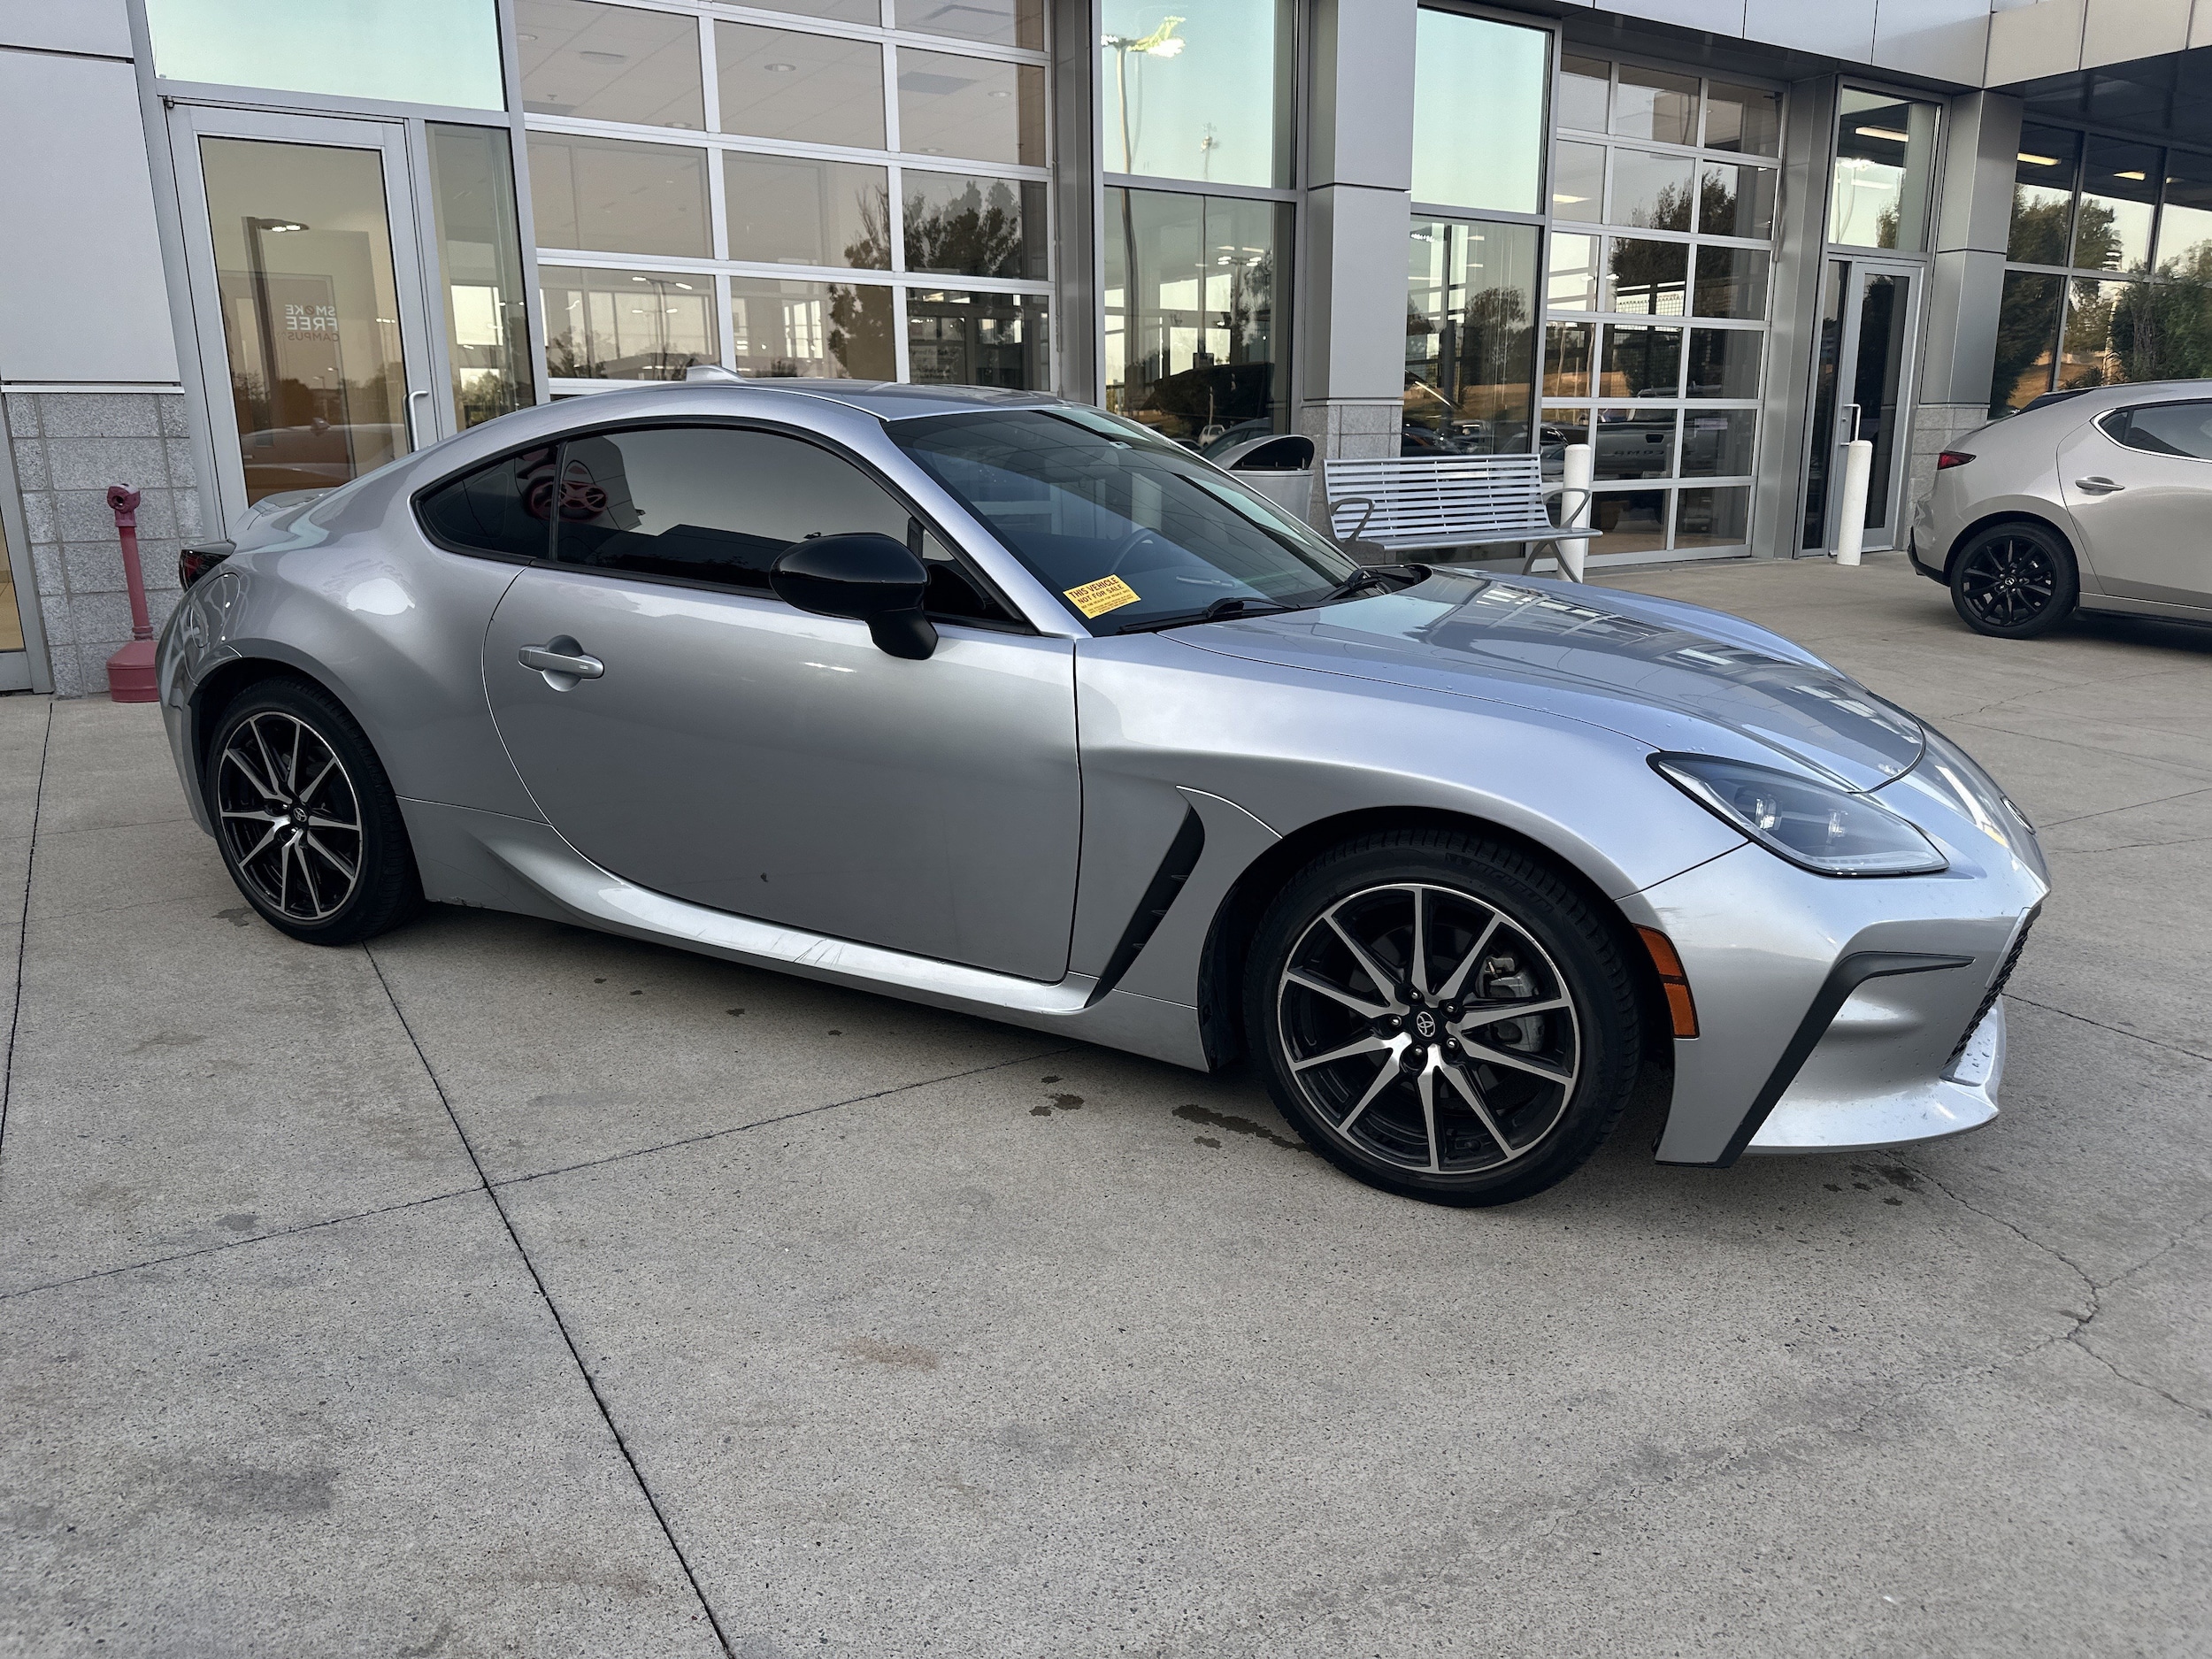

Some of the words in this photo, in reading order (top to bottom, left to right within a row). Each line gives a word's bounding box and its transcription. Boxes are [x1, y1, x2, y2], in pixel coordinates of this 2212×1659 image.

[1069, 588, 1088, 598] THIS
[1087, 577, 1119, 591] VEHICLE
[1077, 595, 1093, 604] NOT
[1105, 584, 1125, 593] SALE
